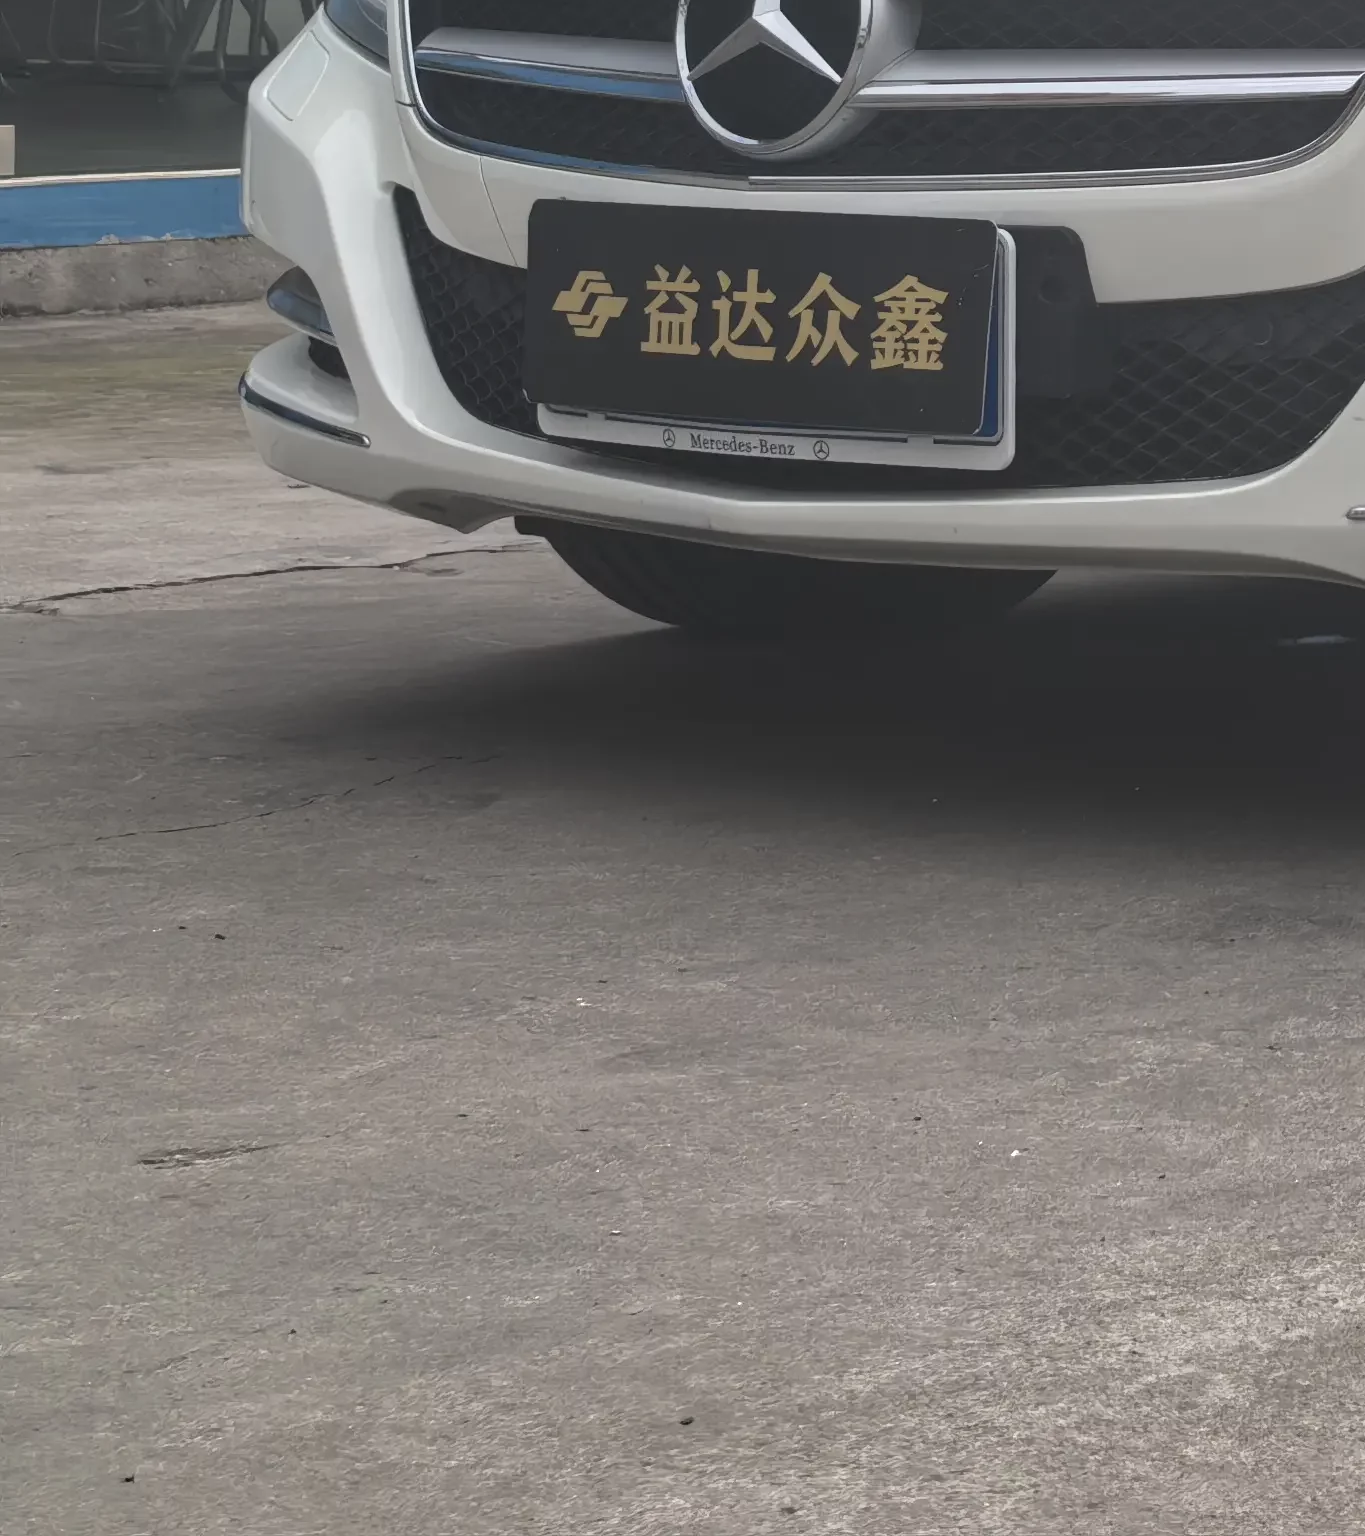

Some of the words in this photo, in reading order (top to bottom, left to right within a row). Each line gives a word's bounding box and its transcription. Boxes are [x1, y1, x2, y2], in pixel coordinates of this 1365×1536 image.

[640, 264, 950, 371] 益达众鑫
[689, 432, 796, 456] Mercedes-Benz
